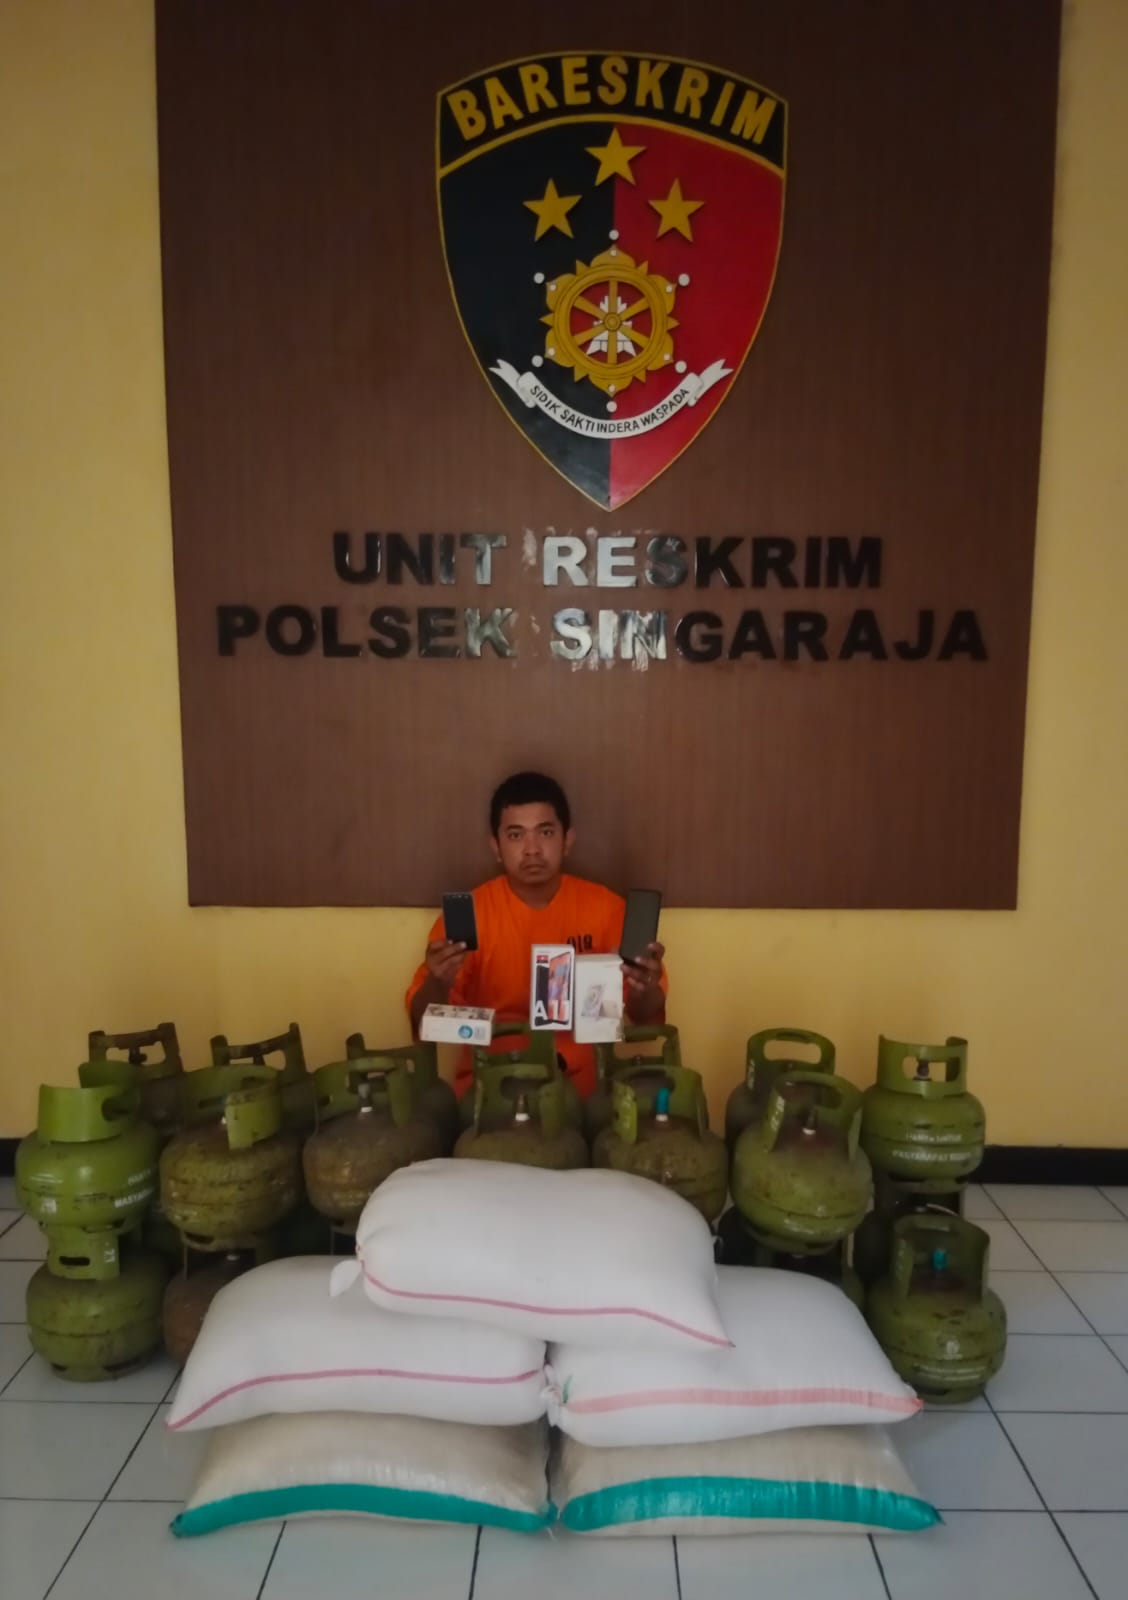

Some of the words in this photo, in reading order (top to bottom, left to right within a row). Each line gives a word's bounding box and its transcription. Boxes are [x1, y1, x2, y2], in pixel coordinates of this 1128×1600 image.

[446, 55, 777, 145] BARESKRIM
[530, 385, 561, 414] SIDIK
[560, 409, 595, 432] SAKTI
[596, 420, 640, 434] INDERA
[640, 388, 690, 427] WASPADA
[332, 532, 507, 586] UNIT
[543, 535, 883, 589] RESKRIM
[215, 604, 518, 659] POLSEK
[550, 607, 989, 663] SINGARAJA
